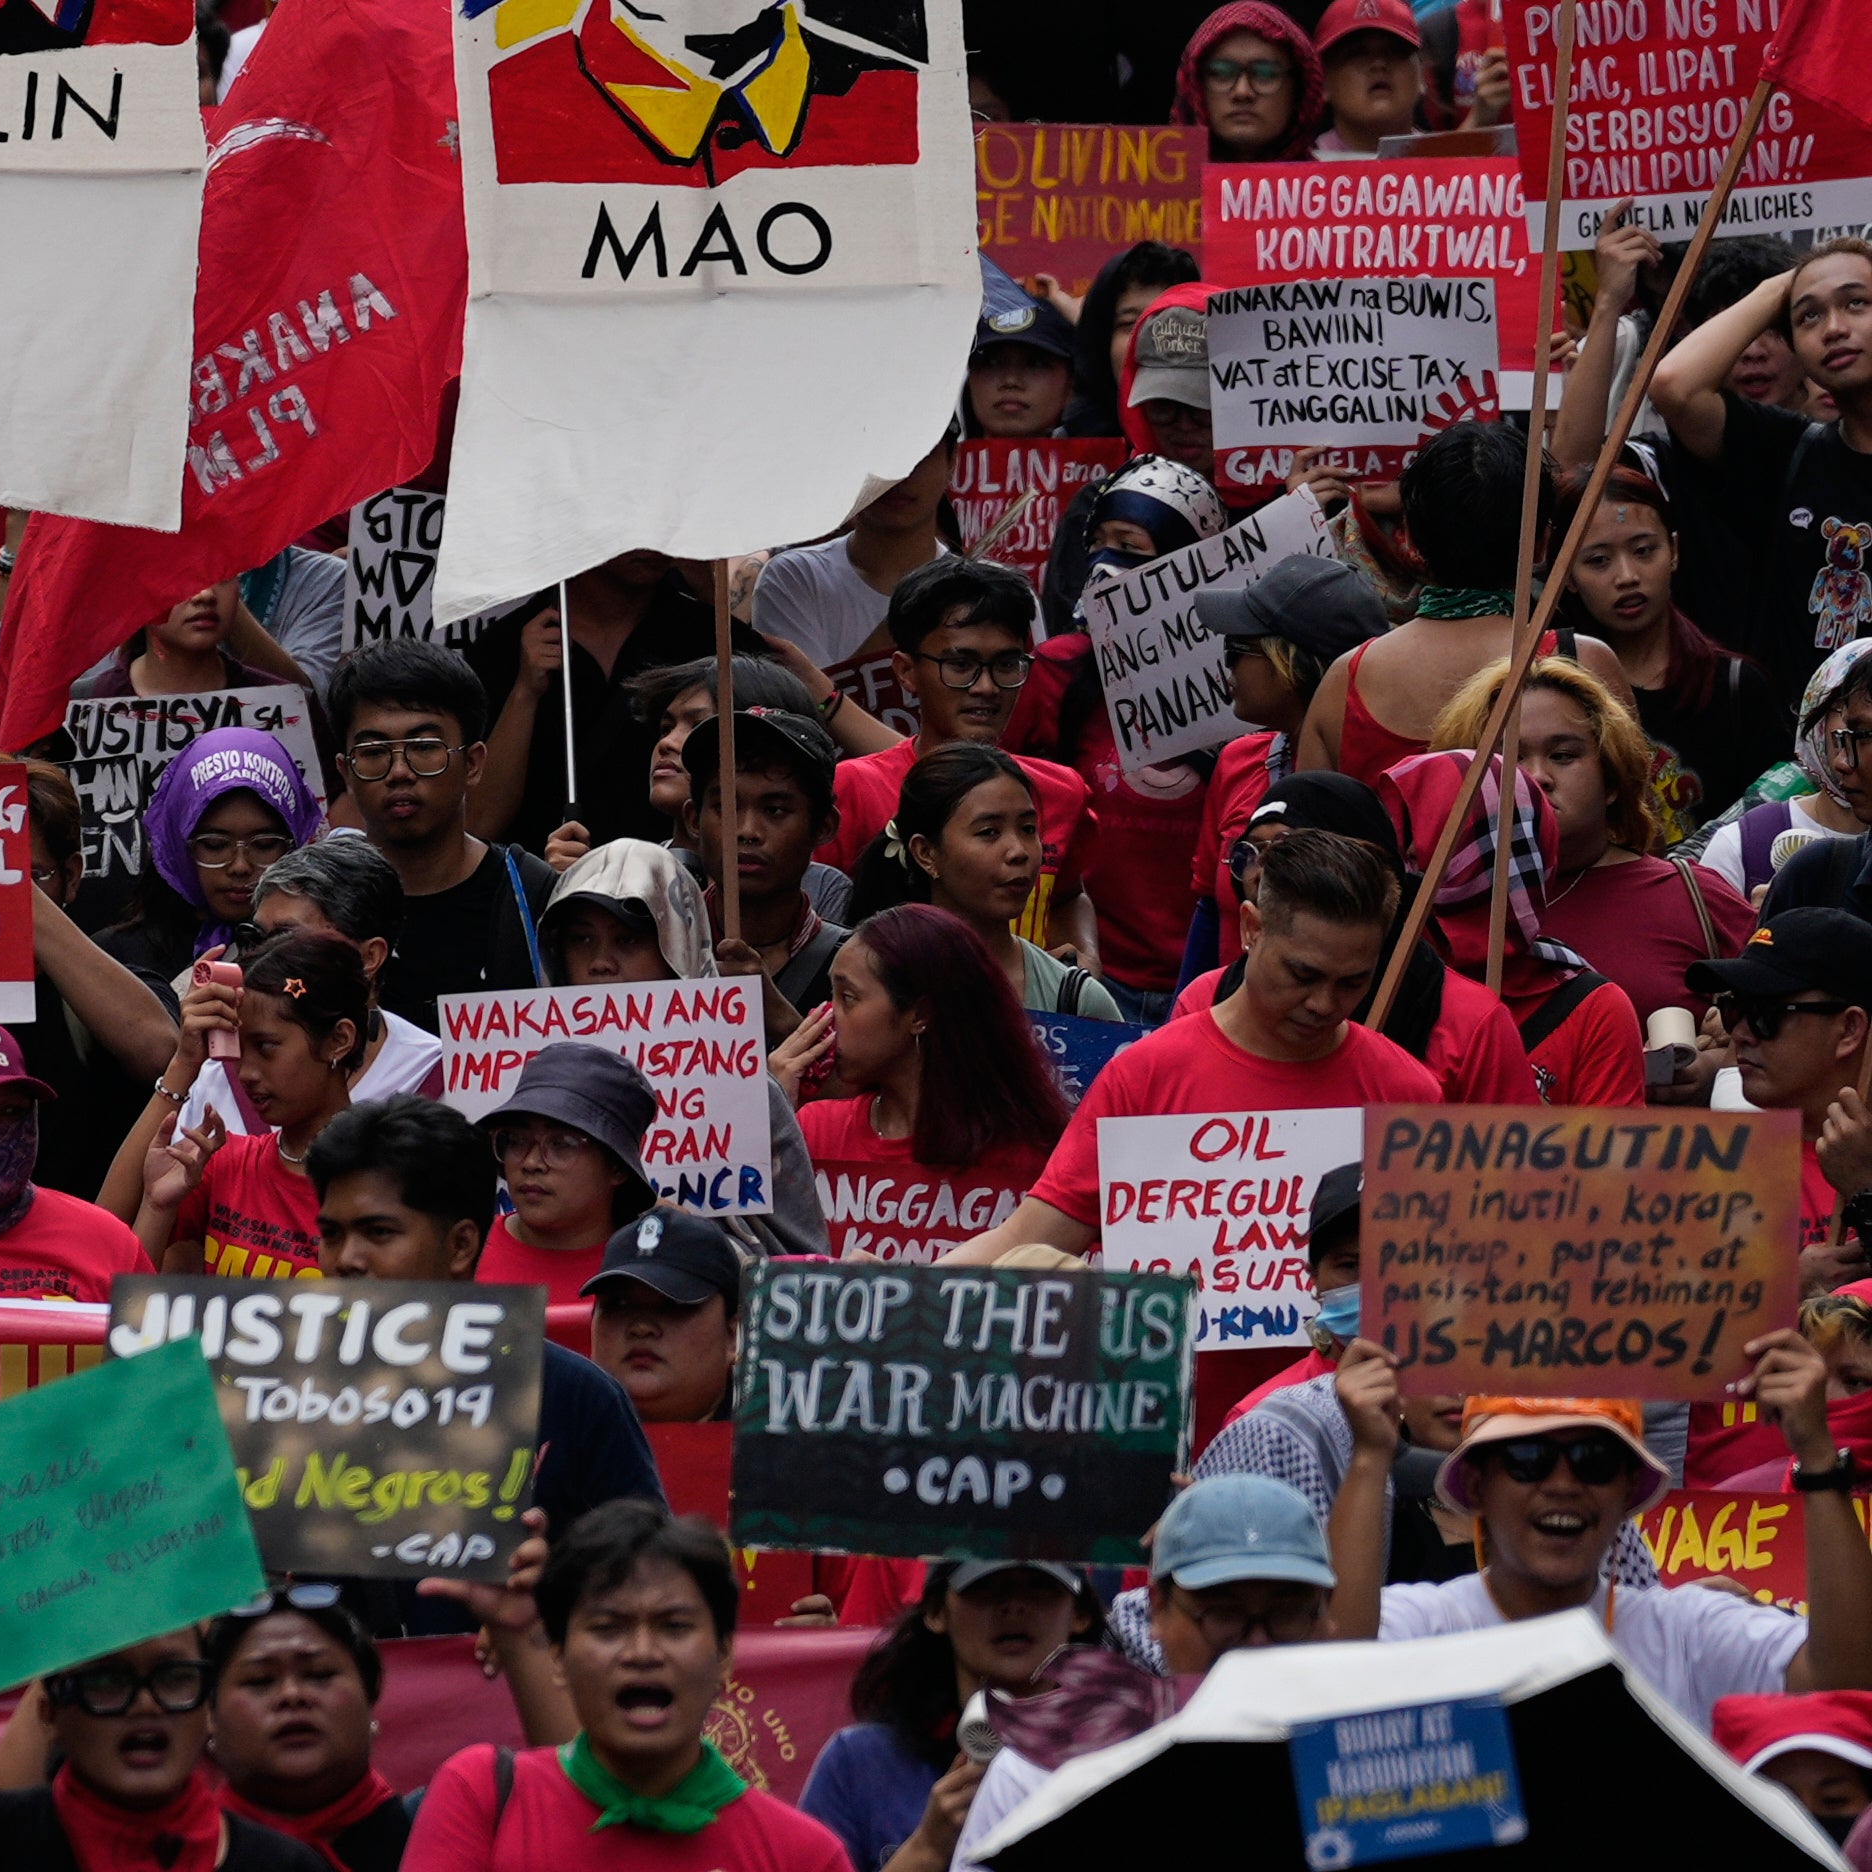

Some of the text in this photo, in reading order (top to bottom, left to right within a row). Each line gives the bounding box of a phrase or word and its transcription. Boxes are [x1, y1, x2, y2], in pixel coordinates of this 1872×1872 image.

[1639, 43, 1737, 97] ILIPAT
[1030, 129, 1188, 188] LIVING
[1032, 196, 1204, 244] NATIONWIDE
[1220, 173, 1526, 221] MANGGAGAWANG
[1578, 192, 1813, 238] GARIELA NOALICHES
[581, 200, 832, 281] MAO
[1256, 224, 1527, 277] KONTRAKTWAL,
[1207, 281, 1492, 325] NINAKAW na BUWIS,
[1151, 318, 1206, 342] Cultural
[1264, 316, 1384, 352] BAWIIN!
[1211, 353, 1469, 392] VAT at EXCISE TAX
[1250, 394, 1429, 428] TANGGALIN!
[363, 488, 446, 550] STO
[1094, 516, 1269, 625] TUTULAN
[1099, 607, 1215, 686] ANG MG
[254, 705, 284, 730] SA
[1115, 674, 1233, 752] PANAN
[190, 750, 241, 791] PRESYO
[444, 986, 747, 1043] WAKASAN ANG
[1190, 1116, 1287, 1162] OIL
[1378, 1118, 1752, 1173] PANAGUTIN
[1106, 1175, 1316, 1226] DEREGUL
[1372, 1190, 1451, 1229] ang
[1213, 1219, 1310, 1256] LAW
[1700, 1238, 1746, 1270] at
[764, 1273, 1178, 1363] STOP THE US
[1590, 1275, 1764, 1317] rehimeng
[109, 1291, 505, 1374] JUSTICE
[1383, 1307, 1727, 1376] US-MARCOS!
[758, 1357, 1170, 1436] WAR MACHINE
[294, 1447, 533, 1525] Negros!
